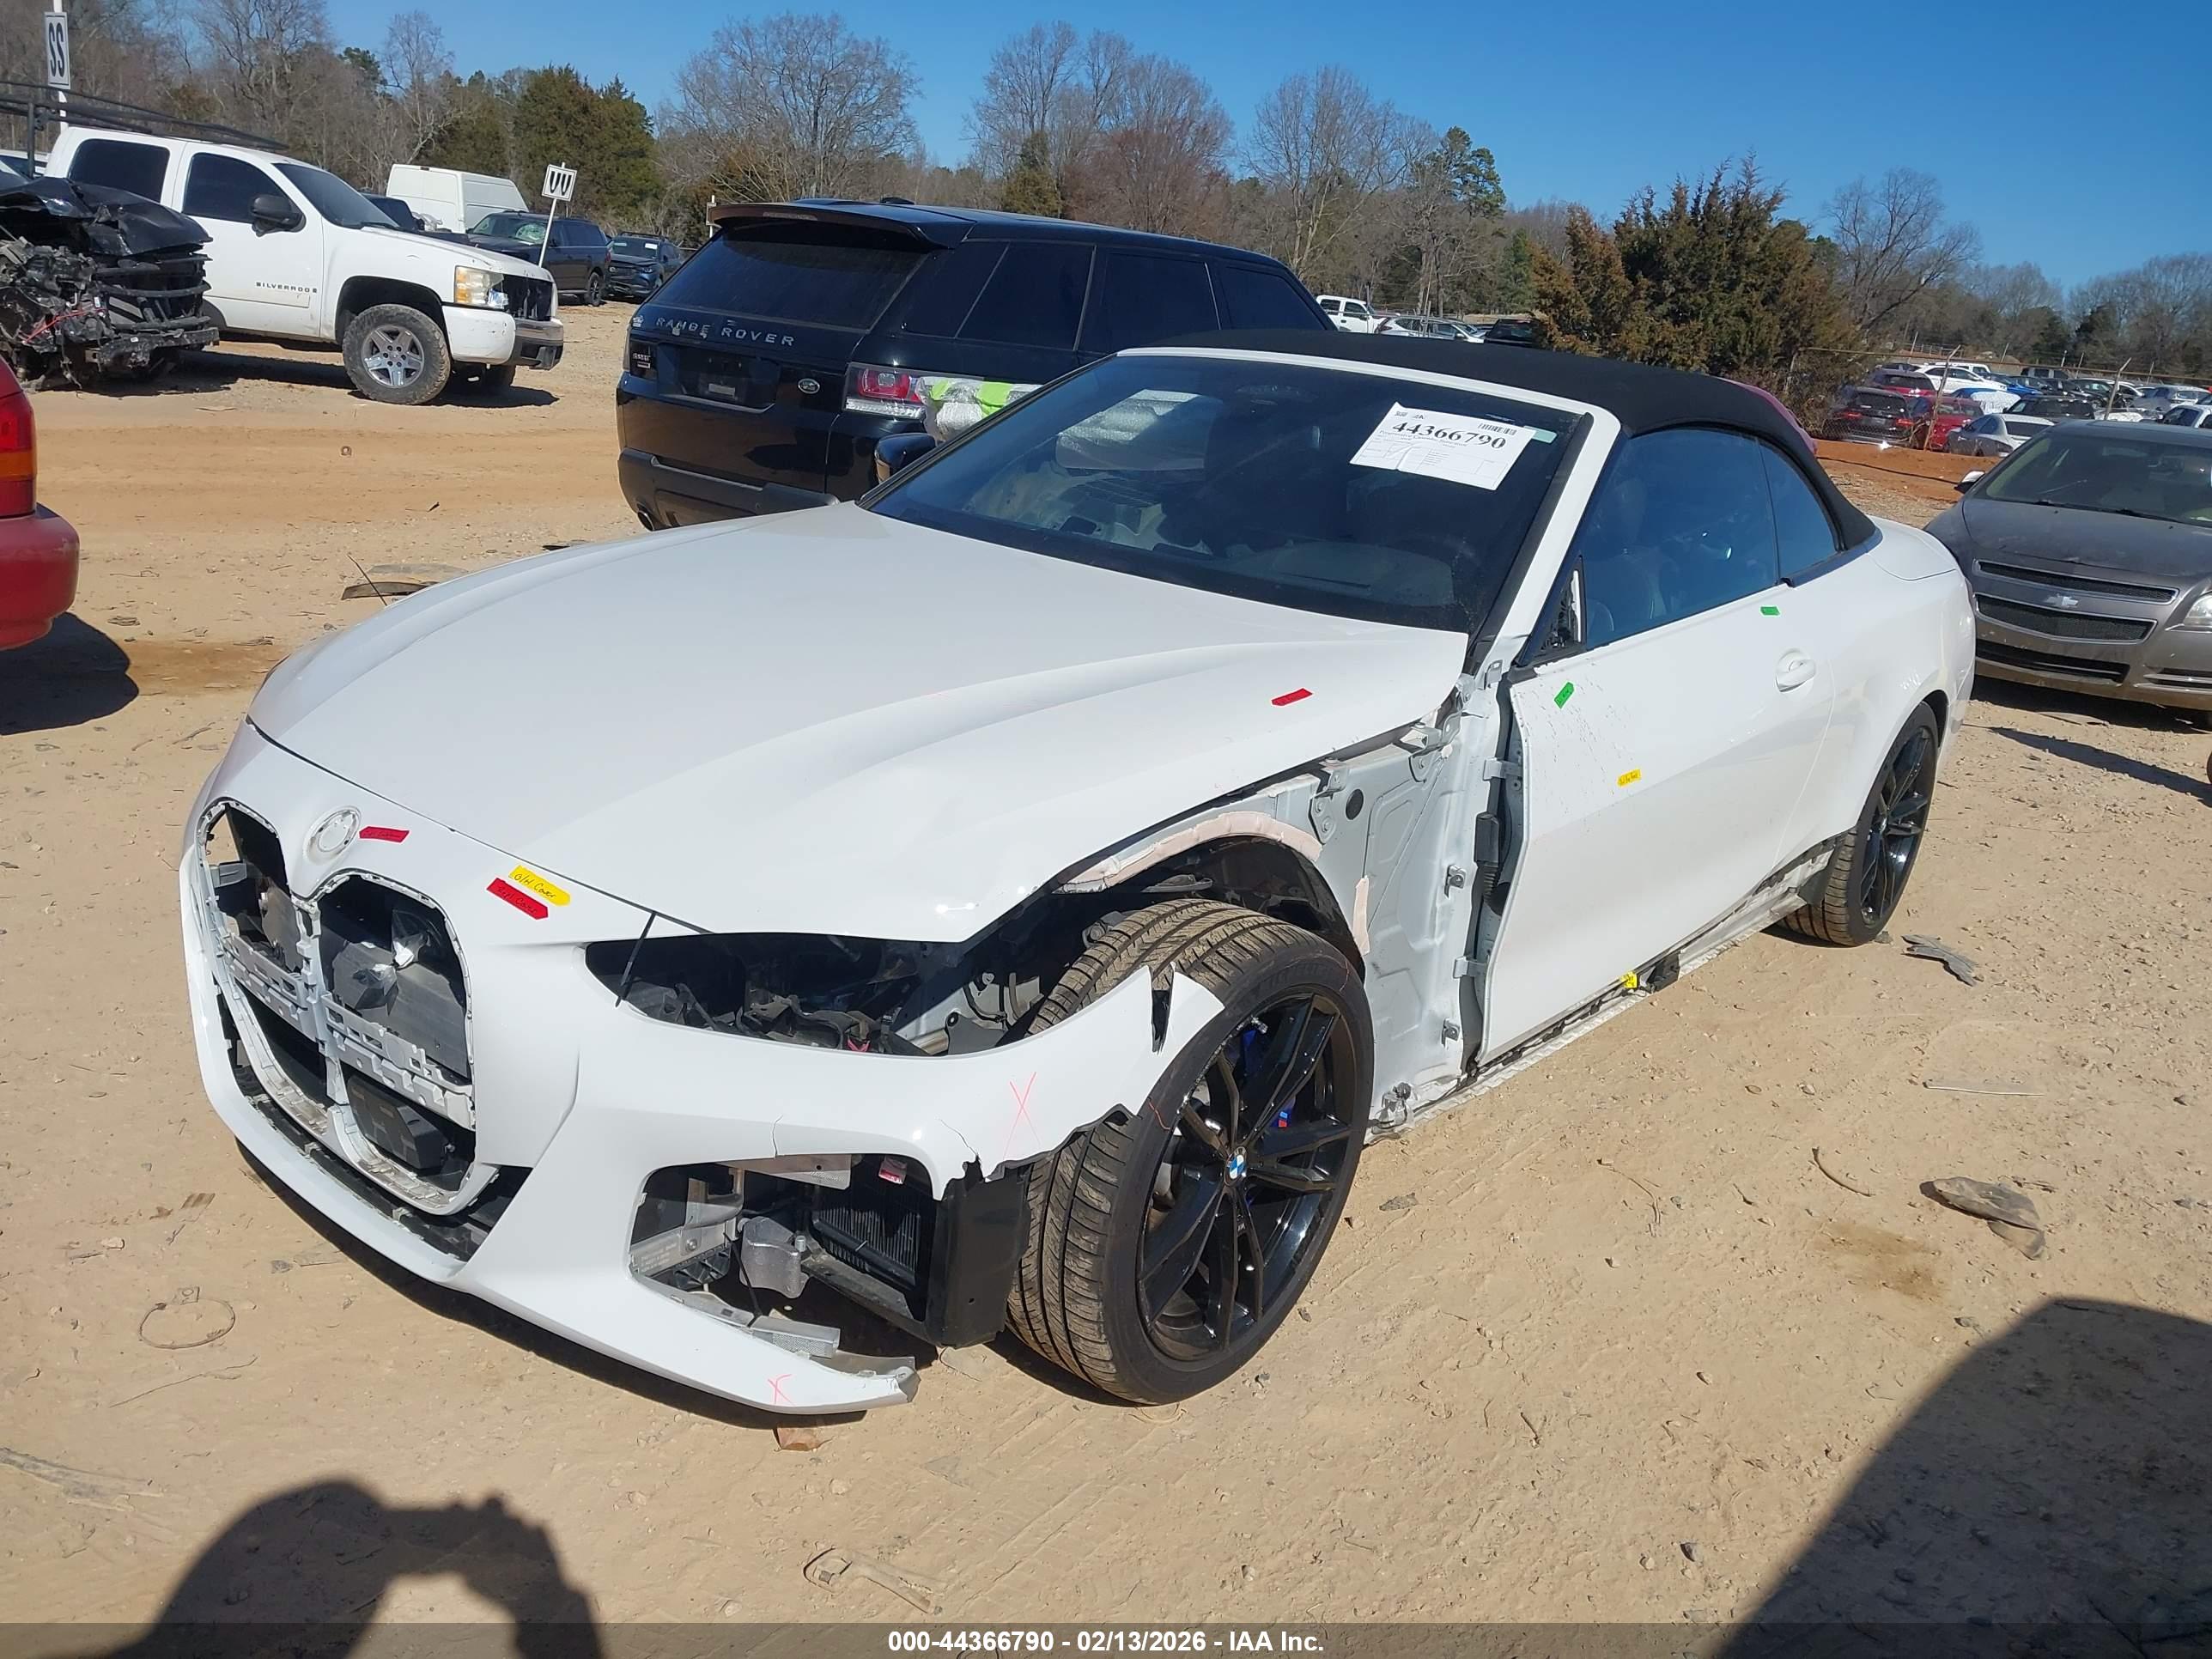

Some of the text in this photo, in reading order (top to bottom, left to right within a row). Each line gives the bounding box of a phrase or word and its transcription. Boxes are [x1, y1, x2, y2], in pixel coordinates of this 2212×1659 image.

[49, 22, 65, 77] SS
[720, 327, 794, 346] ROVER
[1392, 422, 1506, 449] 44366790
